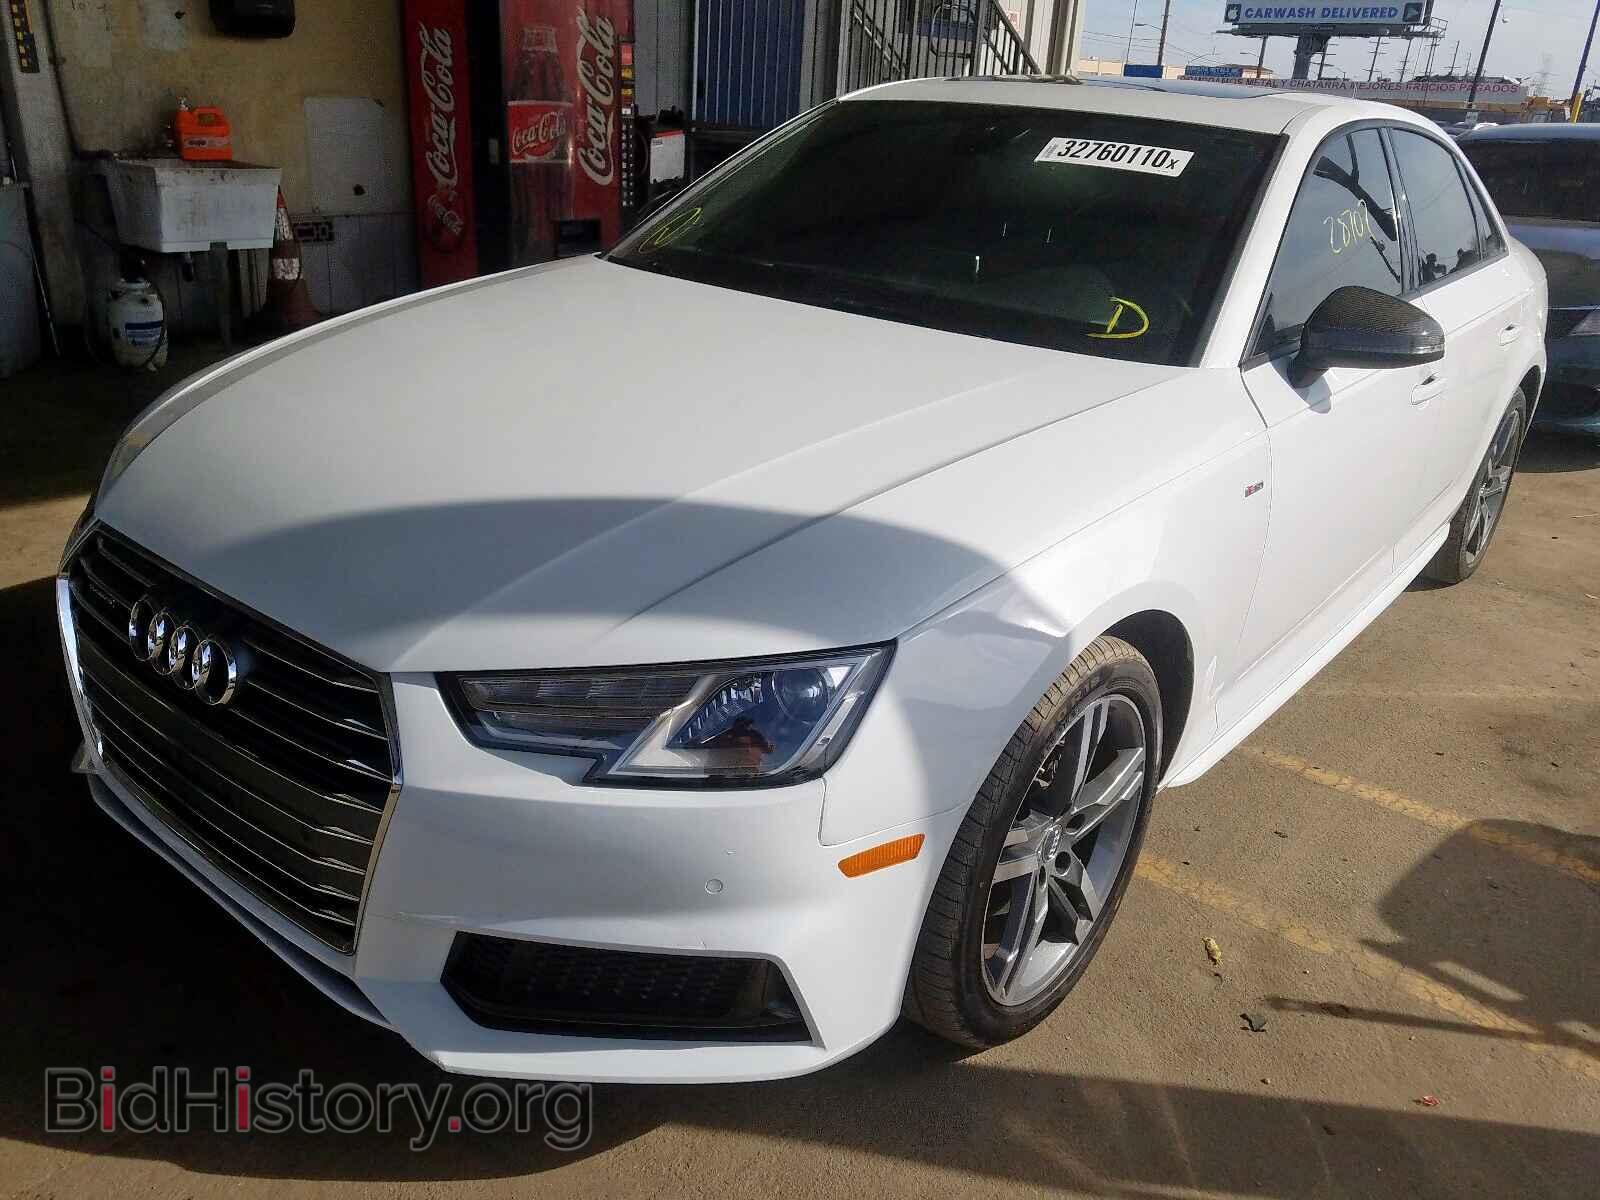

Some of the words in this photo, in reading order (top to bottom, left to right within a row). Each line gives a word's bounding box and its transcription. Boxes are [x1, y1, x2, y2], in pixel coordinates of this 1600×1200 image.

[1245, 7, 1315, 19] CARWASH
[1321, 7, 1398, 19] DELIVERED
[1280, 79, 1288, 88] Y
[1087, 296, 1150, 340] D
